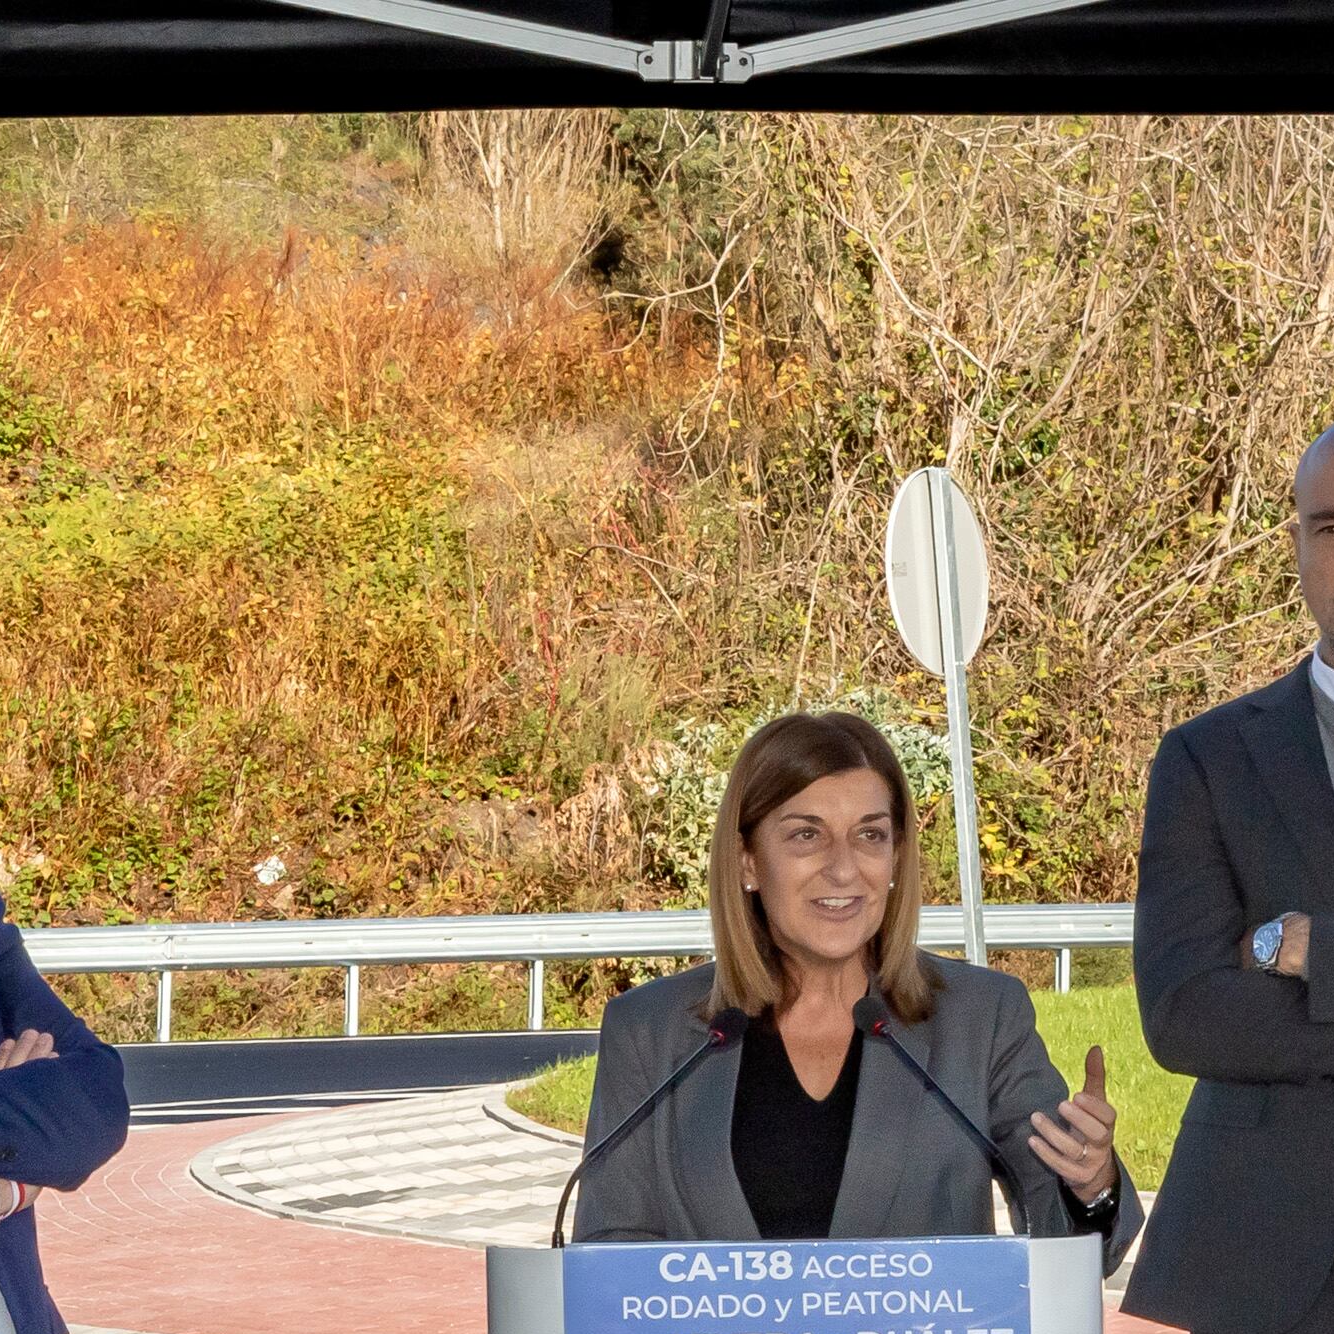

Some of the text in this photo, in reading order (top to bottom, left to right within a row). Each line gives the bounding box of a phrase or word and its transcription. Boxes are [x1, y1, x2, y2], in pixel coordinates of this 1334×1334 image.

[658, 1251, 933, 1282] CA-138 ACCESO
[622, 1290, 974, 1323] RODADO y PEATONAL
